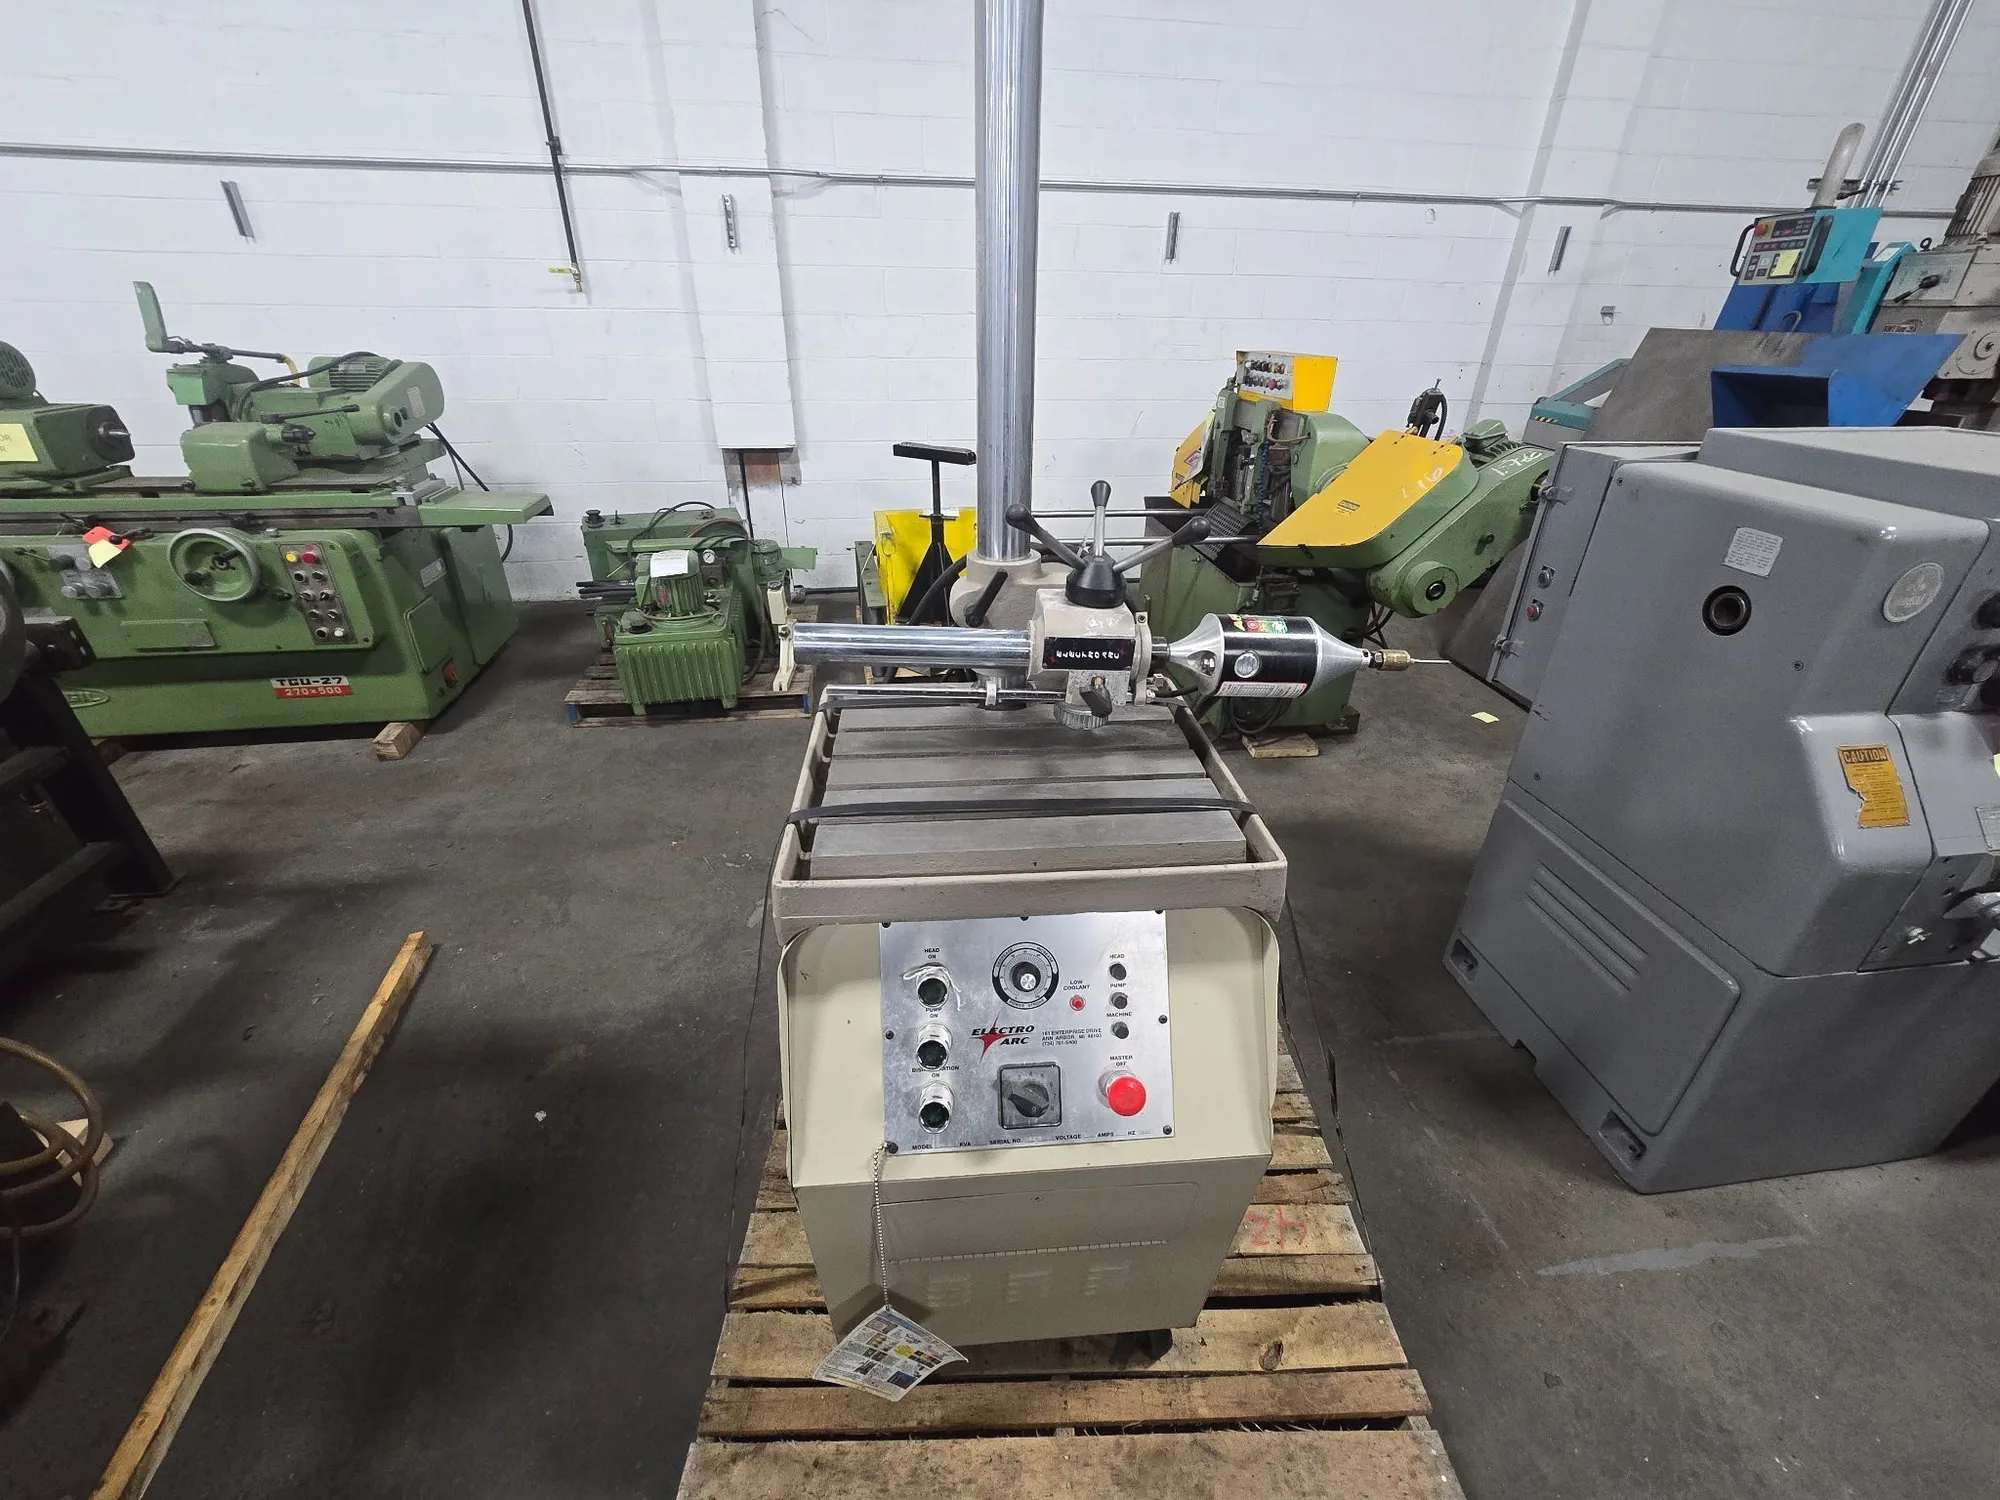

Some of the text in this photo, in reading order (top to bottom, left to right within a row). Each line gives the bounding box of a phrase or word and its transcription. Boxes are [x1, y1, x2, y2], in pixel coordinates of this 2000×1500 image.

[1843, 748, 1887, 763] CAUTION
[971, 1025, 1035, 1035] ELECTRO
[1000, 1037, 1030, 1046] ARC
